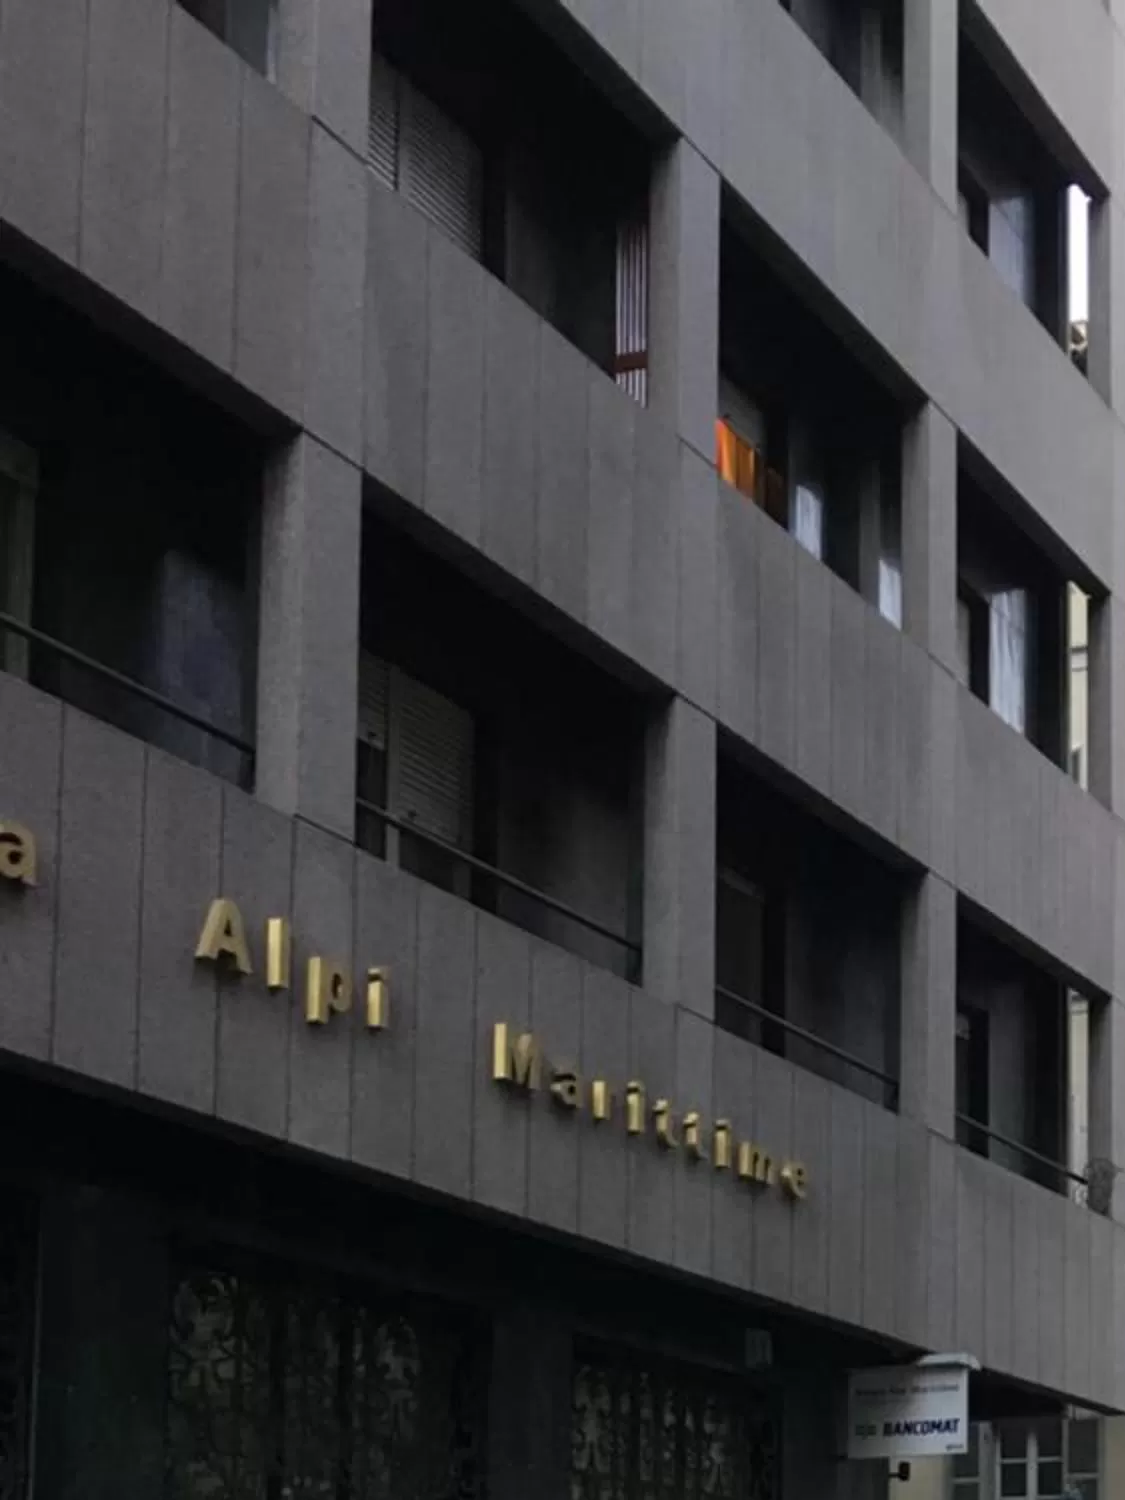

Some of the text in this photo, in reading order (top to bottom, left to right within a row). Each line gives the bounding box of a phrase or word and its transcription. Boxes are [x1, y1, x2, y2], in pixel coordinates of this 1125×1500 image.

[194, 897, 389, 1032] Alpi
[491, 1021, 808, 1199] Marittime
[882, 1418, 961, 1437] BANCOMAT
